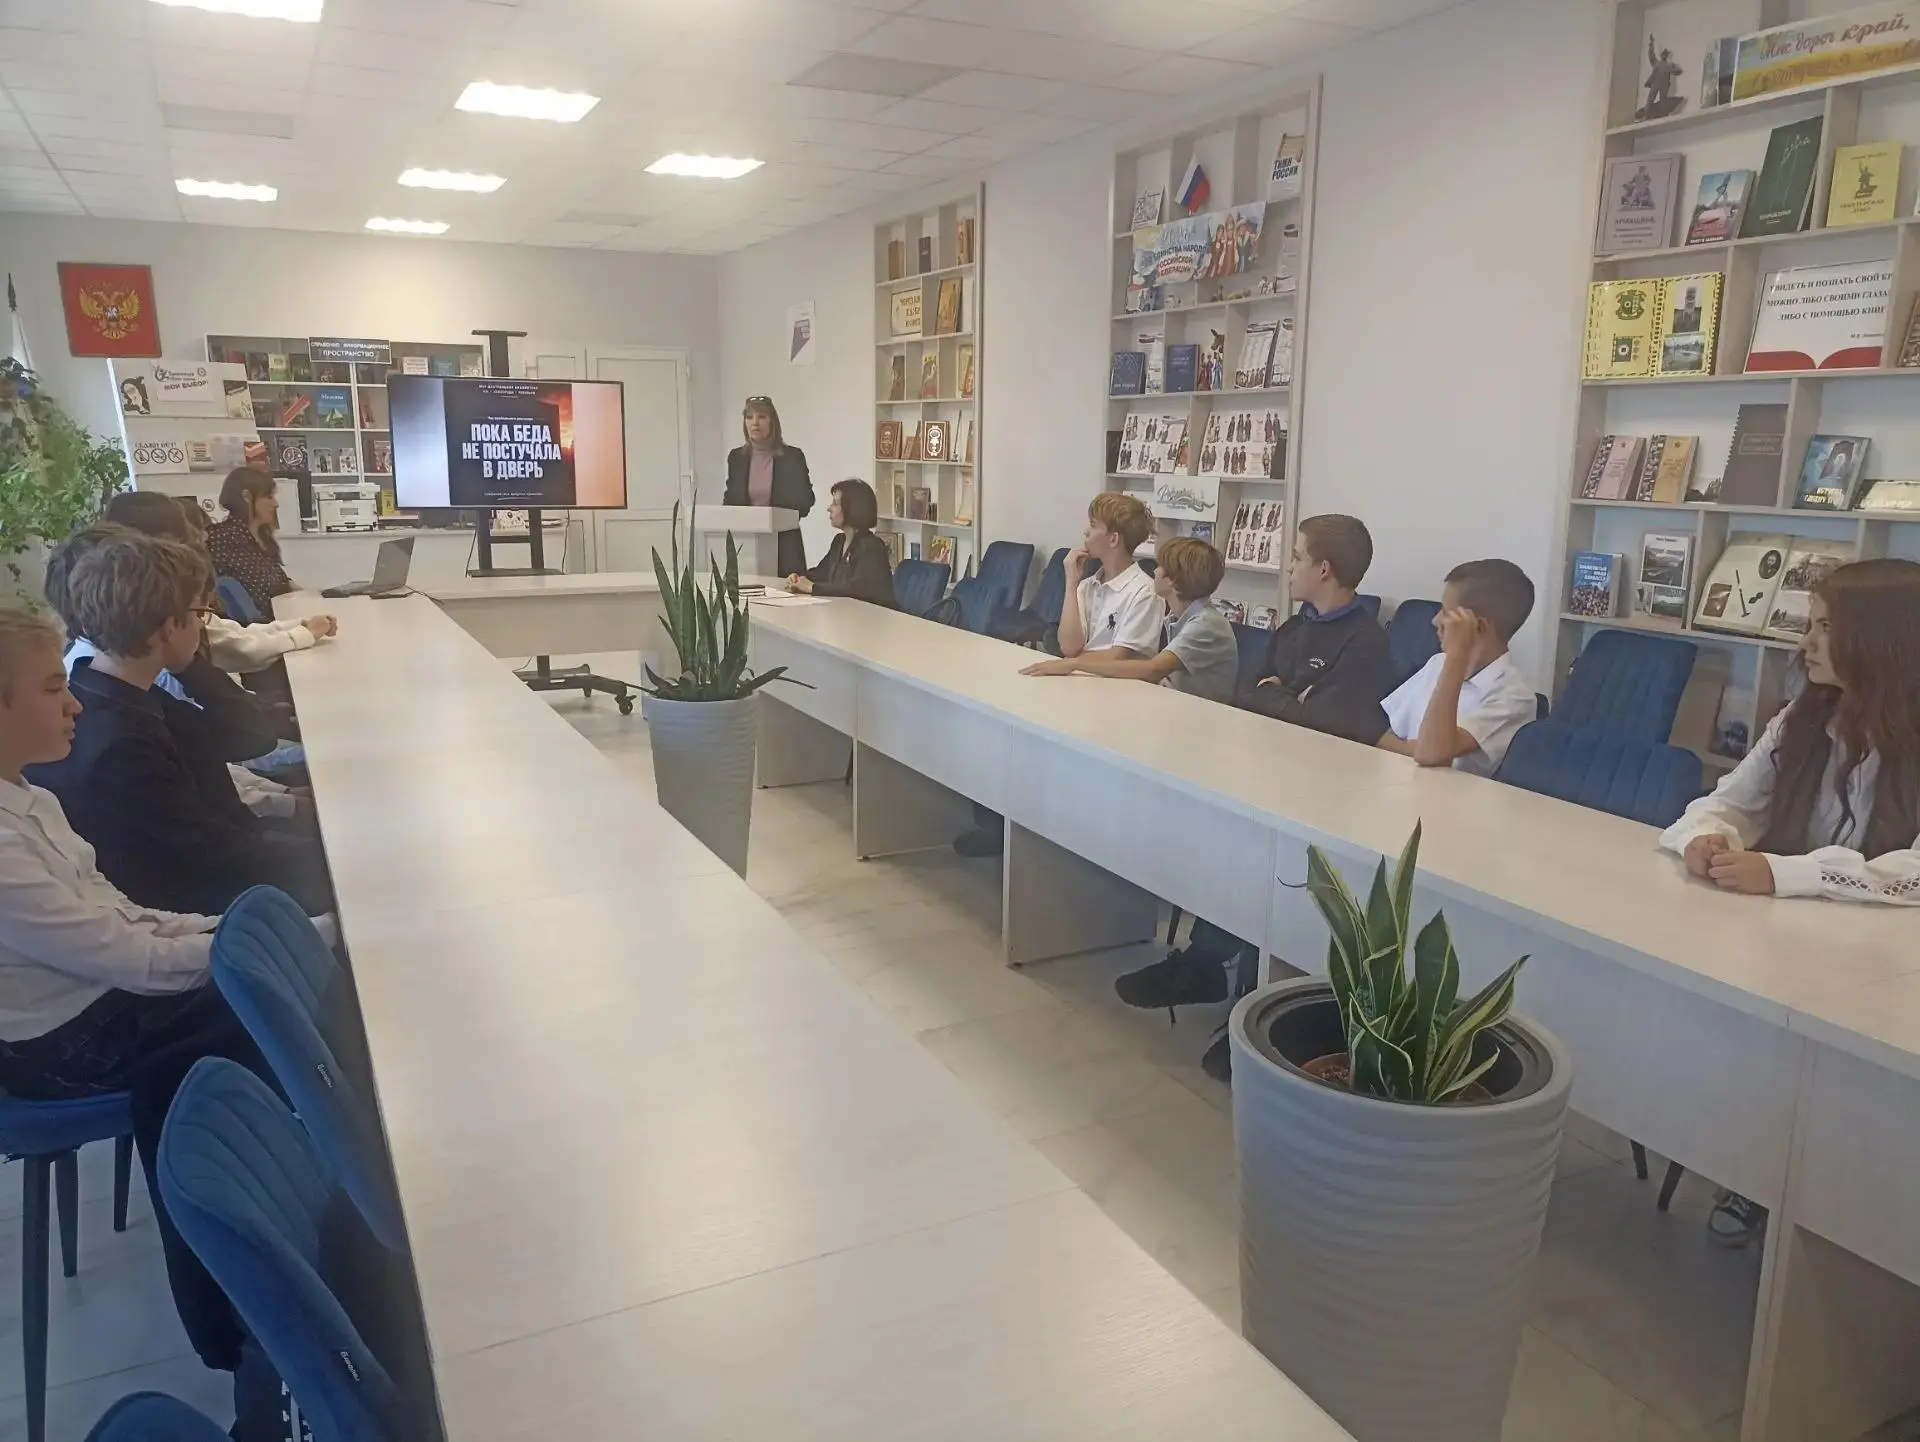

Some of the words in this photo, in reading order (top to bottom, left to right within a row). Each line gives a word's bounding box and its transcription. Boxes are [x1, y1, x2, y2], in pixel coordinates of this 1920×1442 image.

[1760, 36, 1791, 60] Мне
[1796, 32, 1836, 55] дорог
[1840, 13, 1910, 43] край,
[1158, 254, 1193, 268] ОССИЙСКОЙ
[1159, 265, 1192, 277] ЕДЕРАЦИИ
[1855, 274, 1880, 284] СВОЙ
[1767, 298, 1798, 306] МОЖНО
[1800, 296, 1822, 304] ЛИБО
[1823, 292, 1860, 302] СВОИМИ
[1862, 289, 1888, 299] ГЛАЗА
[1777, 312, 1801, 321] ЛИБО
[1810, 308, 1860, 318] ПОМОЩЬЮ
[470, 423, 511, 442] ПОКА
[513, 424, 552, 444] БЕДА
[462, 442, 480, 460] НЕ
[482, 442, 562, 460] ПОСТУЧАЛА
[482, 460, 493, 478] В
[496, 460, 544, 480] ДВЕРЬ
